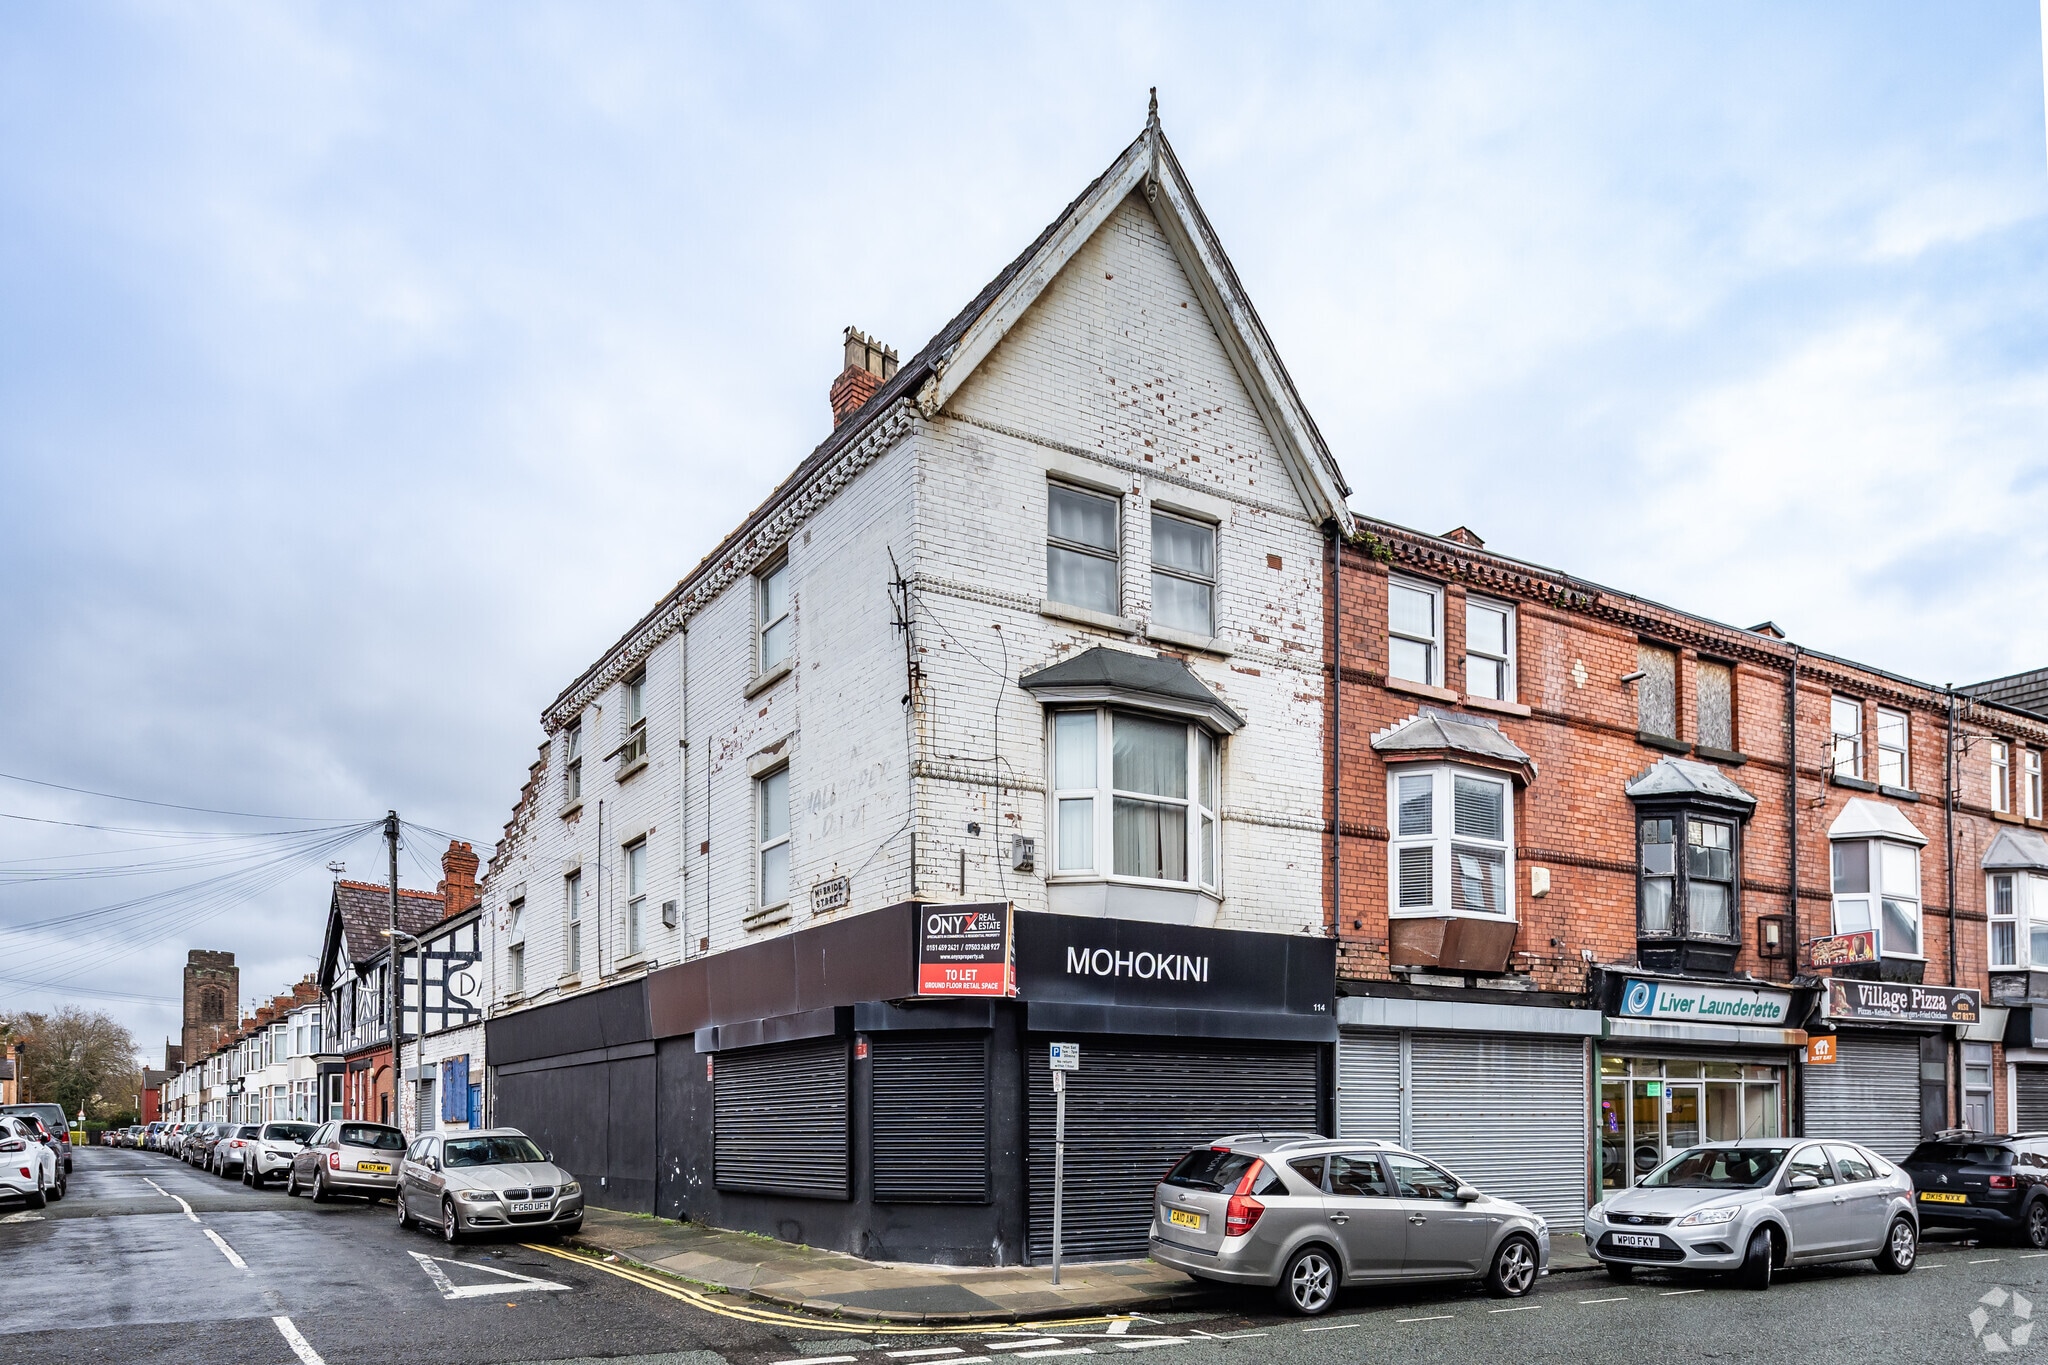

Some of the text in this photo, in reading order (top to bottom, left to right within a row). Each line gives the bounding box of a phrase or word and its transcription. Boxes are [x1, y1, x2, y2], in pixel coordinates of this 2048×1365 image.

[816, 892, 842, 908] STREET
[927, 912, 979, 934] ONYX
[979, 913, 995, 921] REAL
[979, 921, 1000, 930] ESTATE
[1067, 946, 1209, 982] MOHOKINI
[946, 969, 977, 980] TO LET
[1858, 985, 1947, 1013] Village Pizza
[1659, 992, 1780, 1019] Liver Launderette
[1900, 1010, 1917, 1019] Burgers
[1952, 1012, 1975, 1021] 427 8173
[1173, 1212, 1198, 1226] CA10 AMU
[1618, 1236, 1653, 1246] WP10 FKY
